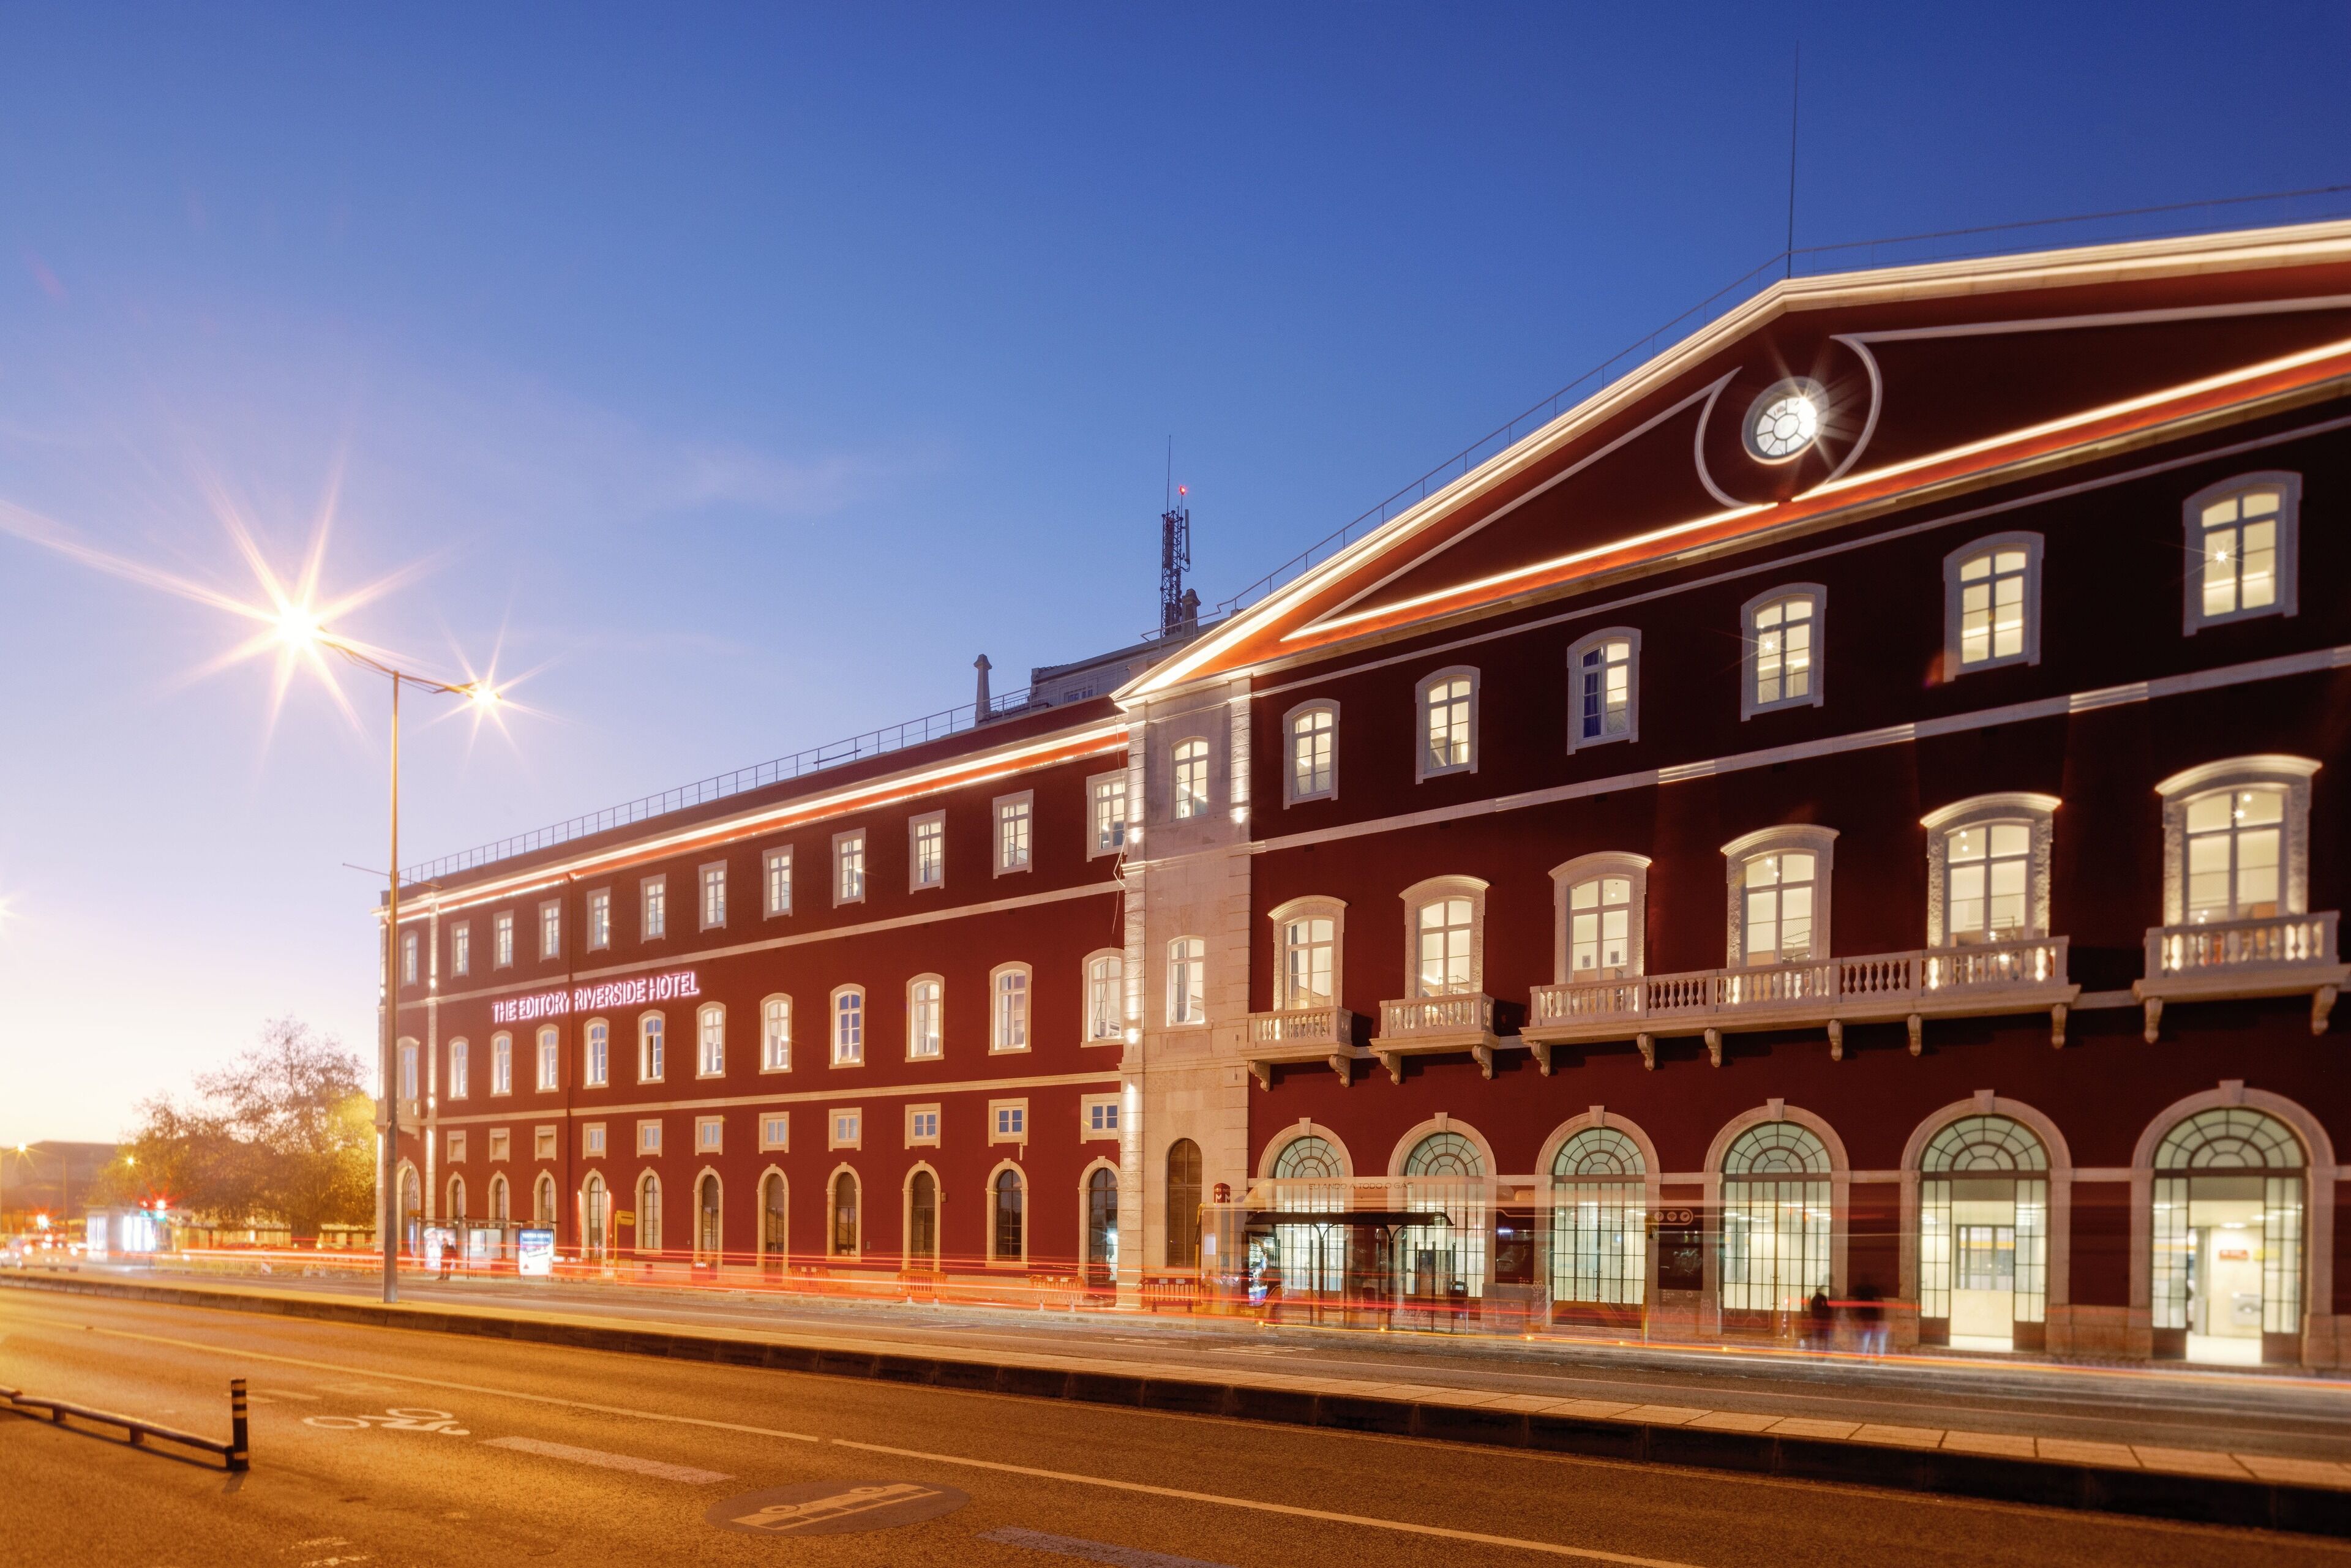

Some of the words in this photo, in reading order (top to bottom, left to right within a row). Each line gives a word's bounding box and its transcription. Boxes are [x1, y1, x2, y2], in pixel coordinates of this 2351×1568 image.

[492, 1000, 517, 1023] THE
[519, 991, 569, 1019] EDITORY
[574, 980, 647, 1010] RIVERSIDE
[648, 972, 700, 1001] HOTEL
